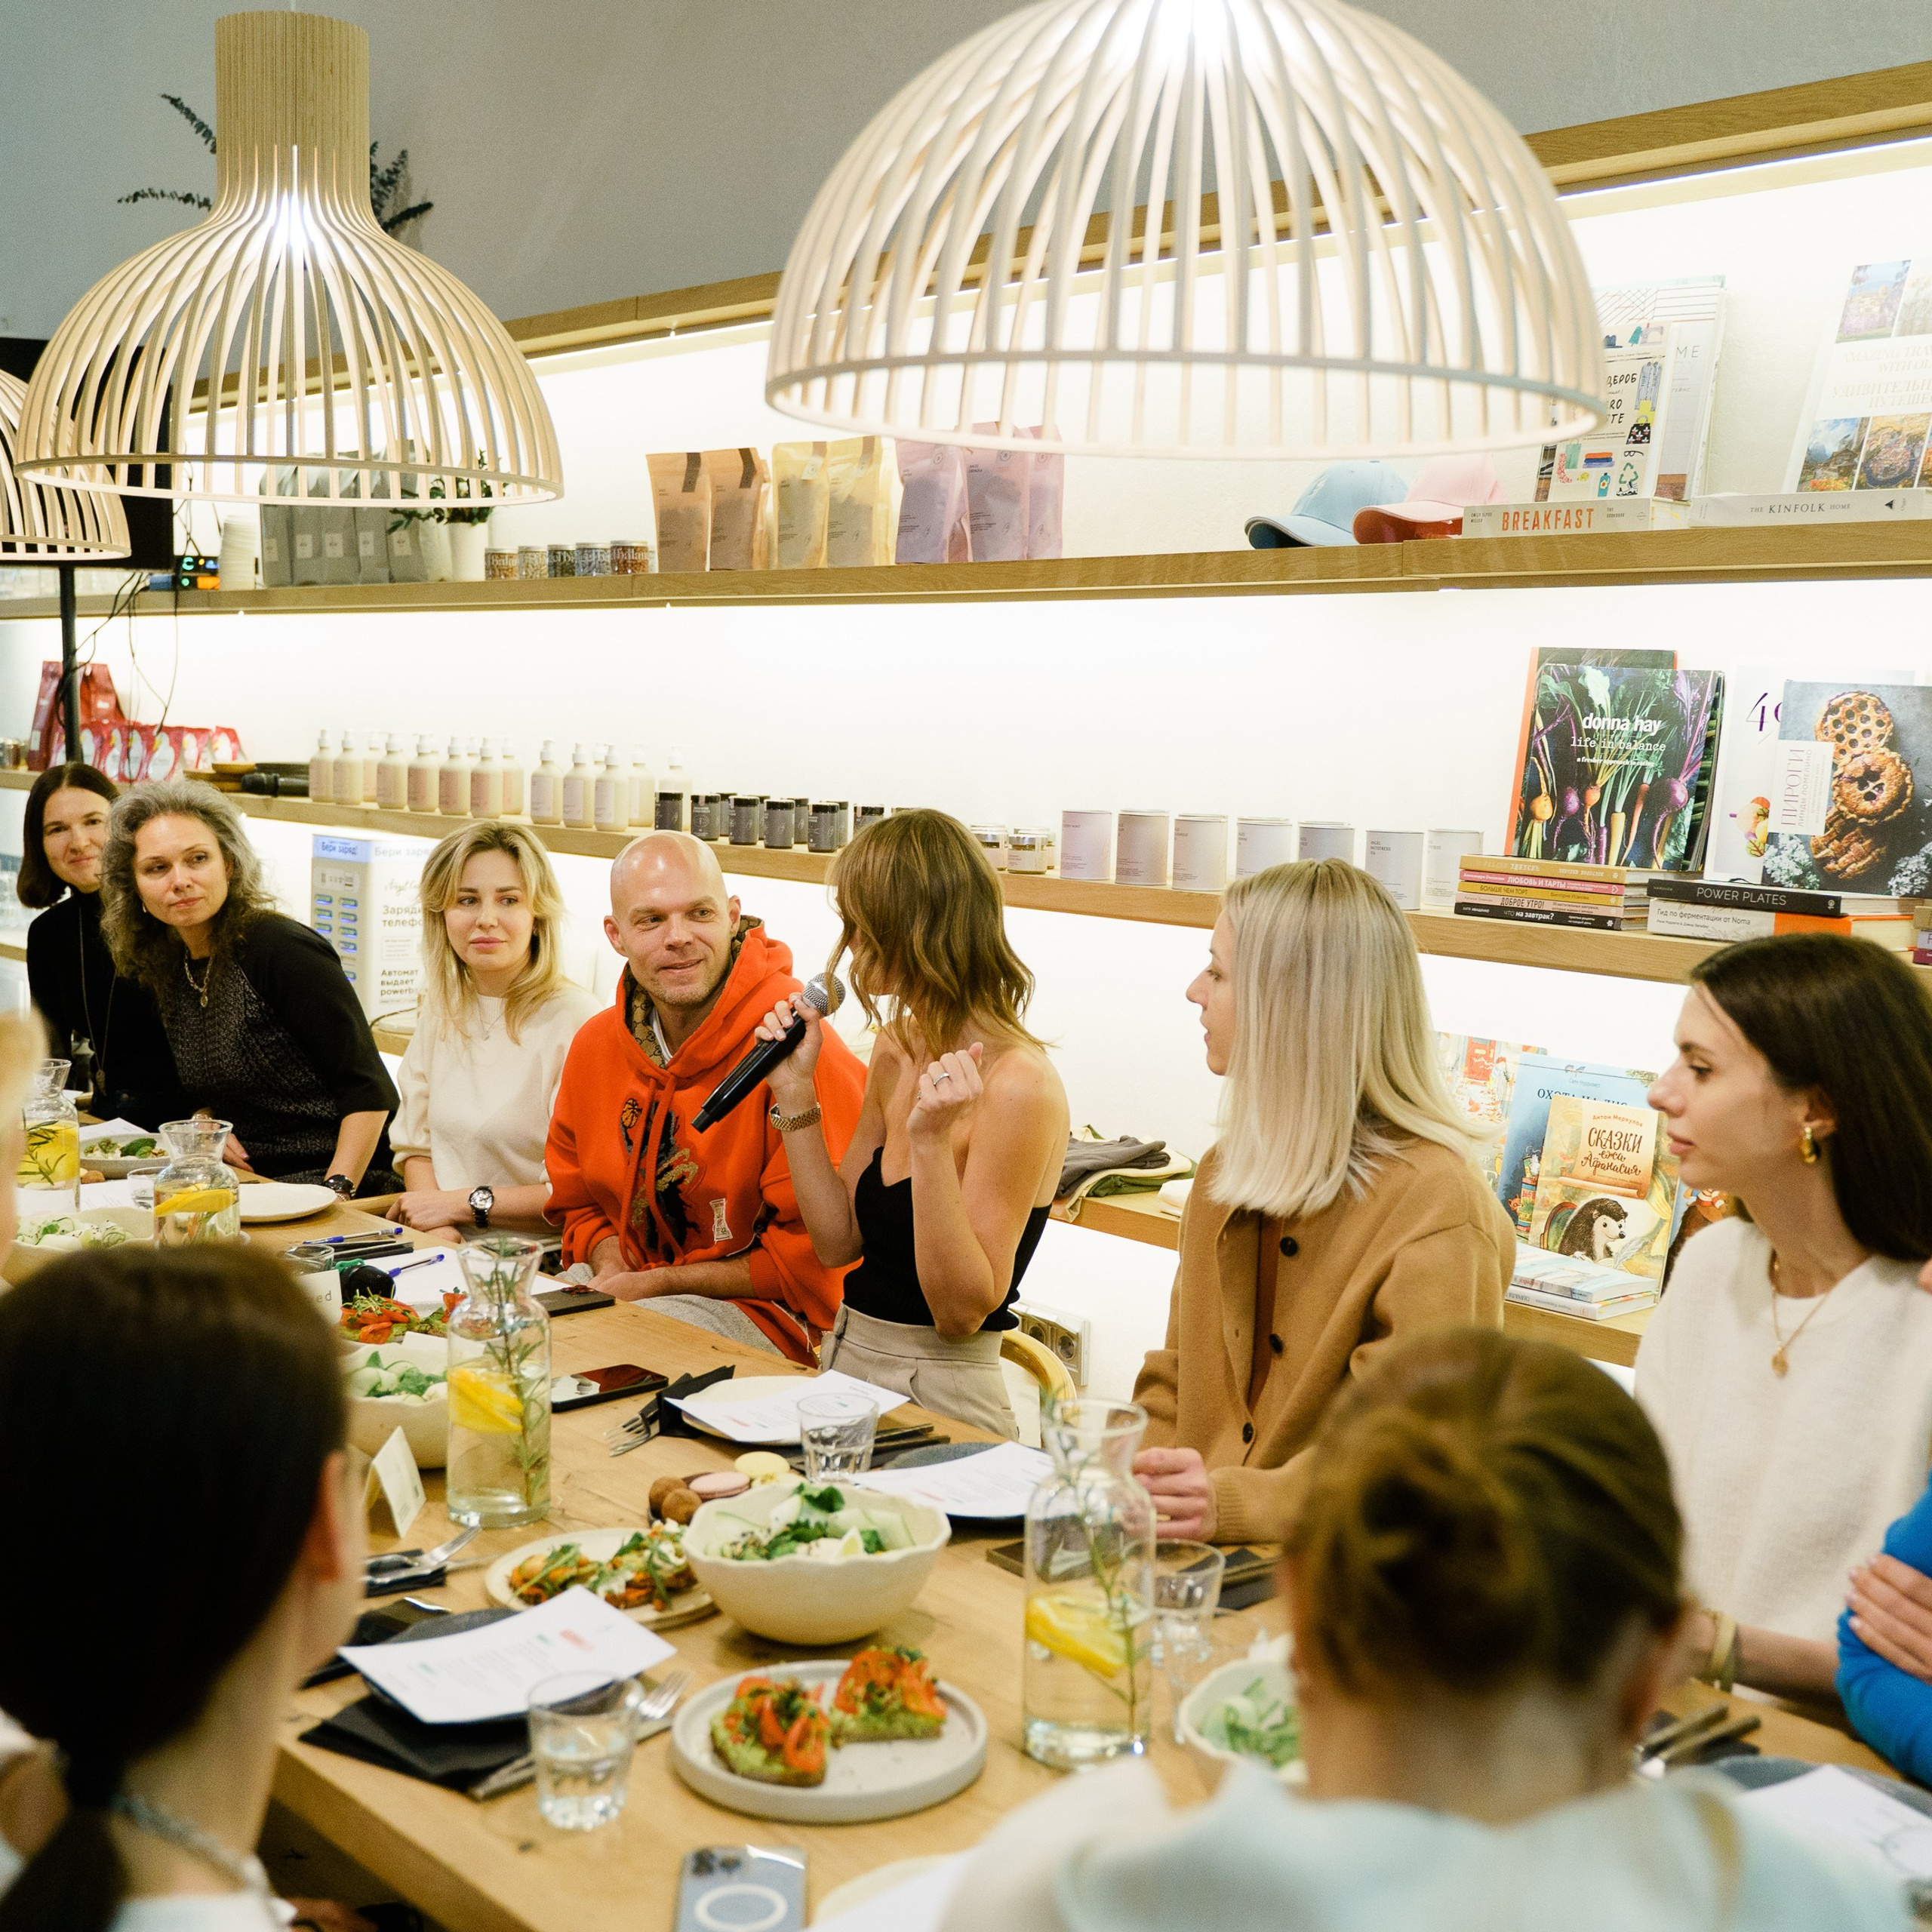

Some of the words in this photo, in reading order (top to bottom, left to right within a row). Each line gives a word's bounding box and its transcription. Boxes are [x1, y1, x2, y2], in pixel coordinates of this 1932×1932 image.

[1676, 345, 1700, 358] ME
[1904, 345, 1932, 358] TRA
[1607, 373, 1638, 388] ДЕРОБ
[1832, 379, 1932, 398] УДИВИТЕЛЬН
[1608, 398, 1623, 411] RO
[1868, 393, 1932, 408] ПУТЕШЕ
[1768, 503, 1826, 514] KINFOLK
[1502, 508, 1595, 531] BREAKFAST
[1582, 712, 1630, 731] donna
[1633, 715, 1663, 737] hay
[1570, 736, 1596, 748] life
[1601, 738, 1614, 749] in
[1619, 737, 1666, 752] balance
[1801, 749, 1812, 795] ЛОМЕЛИНО
[1780, 749, 1804, 826] ПИРОГИ
[1798, 797, 1807, 827] ЛИНДЫ
[321, 841, 336, 853] Бери
[338, 844, 358, 855] заряд!
[374, 847, 402, 857] Бери
[405, 848, 429, 857] заря
[1480, 884, 1502, 893] БОЛЬШЕ
[1507, 876, 1537, 885] ЛЮБОВЬ
[1544, 880, 1566, 888] ТАРТЫ
[1500, 897, 1524, 907] ДОБРОЕ
[1526, 900, 1545, 909] УТРО!
[1697, 887, 1739, 901] POWER
[1742, 891, 1786, 906] PLATES
[382, 918, 423, 928] телефо
[1524, 912, 1554, 921] завтрак?
[1657, 908, 1668, 917] Гид
[1678, 910, 1722, 922] ферментации
[1732, 917, 1751, 925] Noma
[380, 987, 414, 996] powerb
[1613, 1114, 1643, 1128] Меркулов
[1588, 1127, 1643, 1153] СКАЗКИ
[1598, 1150, 1626, 1162] ежа
[1580, 1151, 1641, 1176] Афанасия
[316, 1290, 332, 1303] ed
